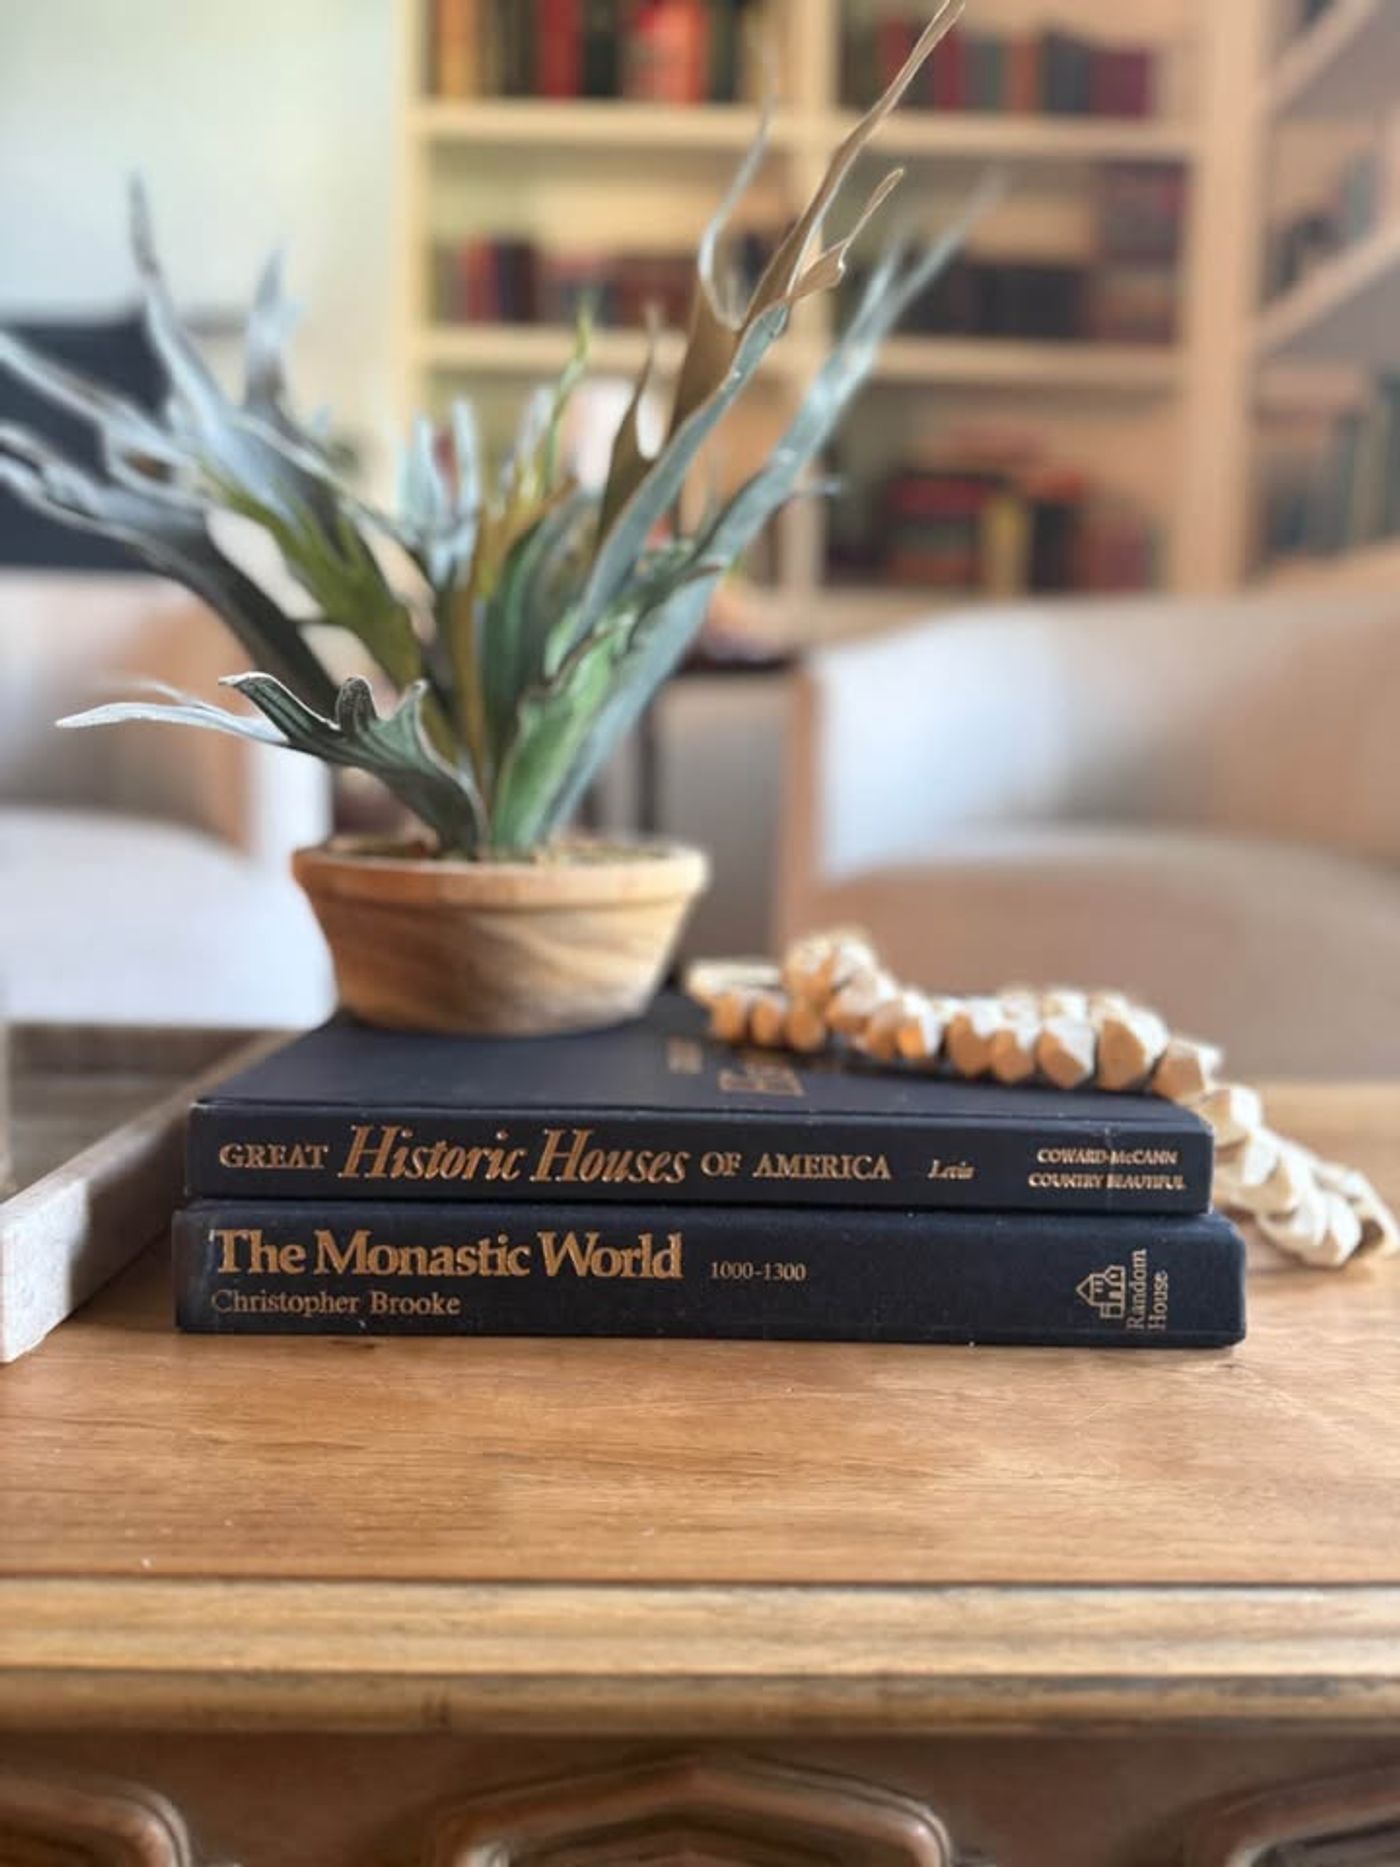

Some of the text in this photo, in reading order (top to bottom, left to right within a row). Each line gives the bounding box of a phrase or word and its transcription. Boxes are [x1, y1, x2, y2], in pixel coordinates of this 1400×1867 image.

[218, 1124, 892, 1184] GREAT Historic Houses OF AMERICA
[1028, 1170, 1187, 1192] COUNTRY BEAUTIFUL
[210, 1228, 684, 1280] The Monastic World
[709, 1259, 807, 1282] 1000-1300
[210, 1289, 462, 1318] Christopher Brooke
[1126, 1248, 1147, 1330] Random
[1148, 1269, 1168, 1330] House
